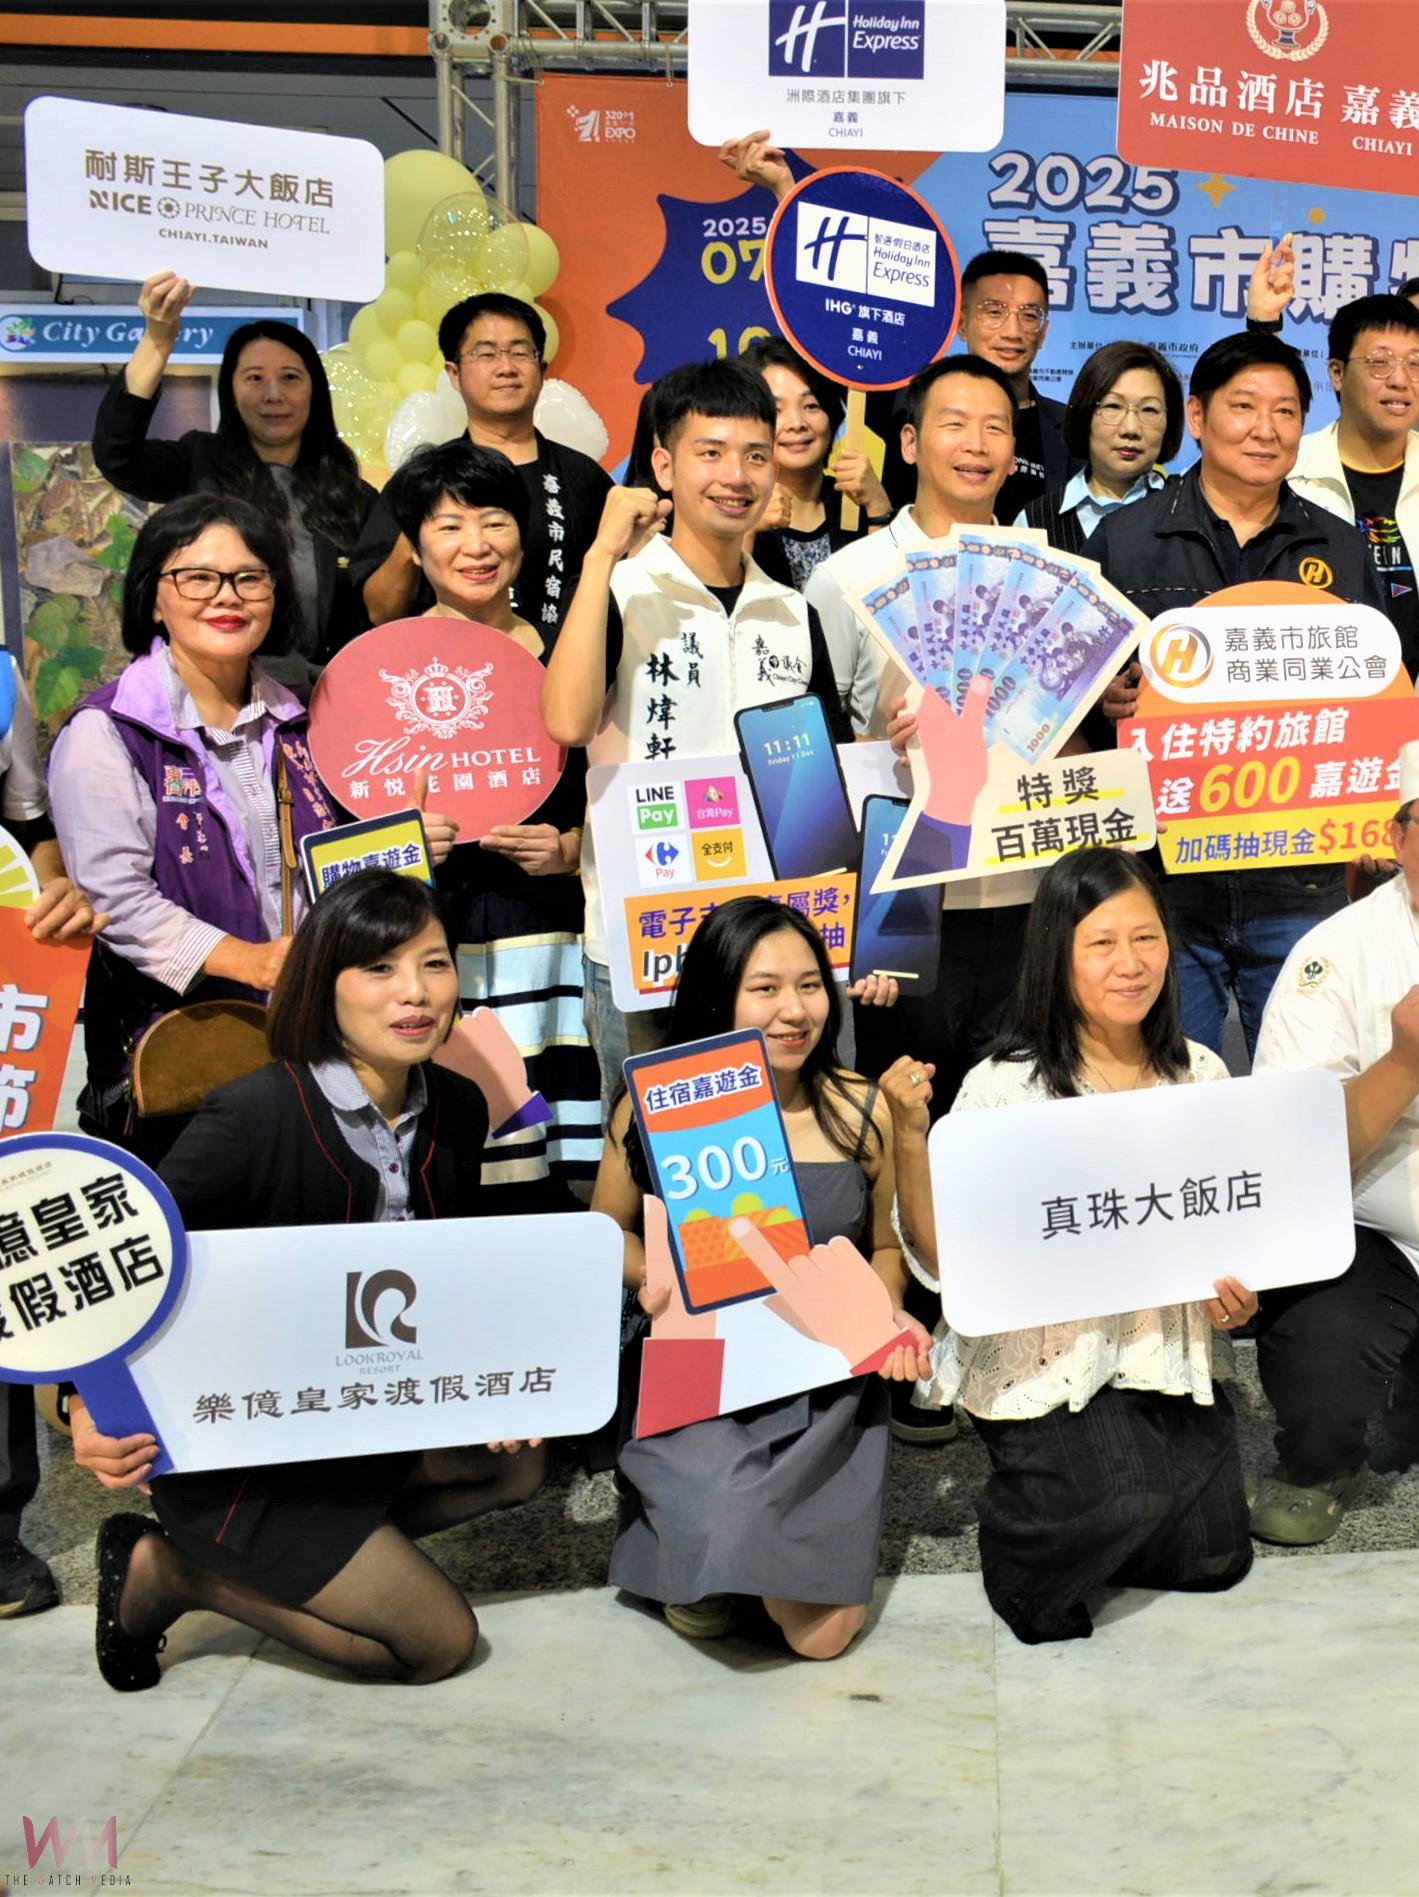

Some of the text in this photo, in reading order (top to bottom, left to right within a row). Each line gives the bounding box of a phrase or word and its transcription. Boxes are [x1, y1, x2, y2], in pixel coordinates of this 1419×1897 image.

[853, 15, 920, 31] Holiday Inn
[853, 31, 919, 53] Express
[787, 89, 906, 104] 洲際酒店集團旗下
[1139, 59, 1324, 119] 兆品酒店
[833, 111, 858, 123] 嘉義
[828, 127, 863, 138] CHIAYI
[1150, 112, 1413, 156] MAISON DE CHINE CHIAYI
[85, 149, 334, 208] 耐斯王子大飯店
[988, 150, 1181, 213] 2025
[89, 190, 331, 234] NICE PRINCE HOTEL
[158, 228, 269, 249] CHIAYI.TAIWAN
[703, 216, 766, 237] 2025
[702, 239, 765, 285] 07
[874, 247, 930, 268] Holiday Inn
[873, 262, 930, 287] Express
[826, 299, 905, 326] IHG 旗下酒店
[43, 321, 213, 348] City Gary
[852, 328, 879, 344] 嘉義
[848, 345, 882, 360] CHIAYI
[1225, 625, 1359, 653] 嘉義市旅館
[682, 632, 704, 688] 議員
[1227, 655, 1388, 684] 商業同業公會
[645, 653, 680, 760] 林煒軒
[764, 733, 811, 756] 11:11
[1027, 723, 1051, 753] 1000
[1130, 707, 1349, 763] 入住特約旅館
[342, 736, 541, 778] Hsin HOTEL
[636, 786, 675, 802] LINE
[1017, 767, 1099, 811] 特獎
[640, 807, 675, 824] Pay
[991, 808, 1137, 861] 百萬現金
[701, 841, 734, 856] 全支付
[656, 867, 675, 879] Pay
[820, 921, 845, 950] 抽
[646, 1066, 761, 1113] 住宿嘉遊金
[1040, 1170, 1264, 1241] 真珠大飯店
[336, 1350, 424, 1366] LOOKROYAL
[359, 1364, 401, 1375] RESORT
[192, 1366, 558, 1424] 樂億皇家渡假酒店
